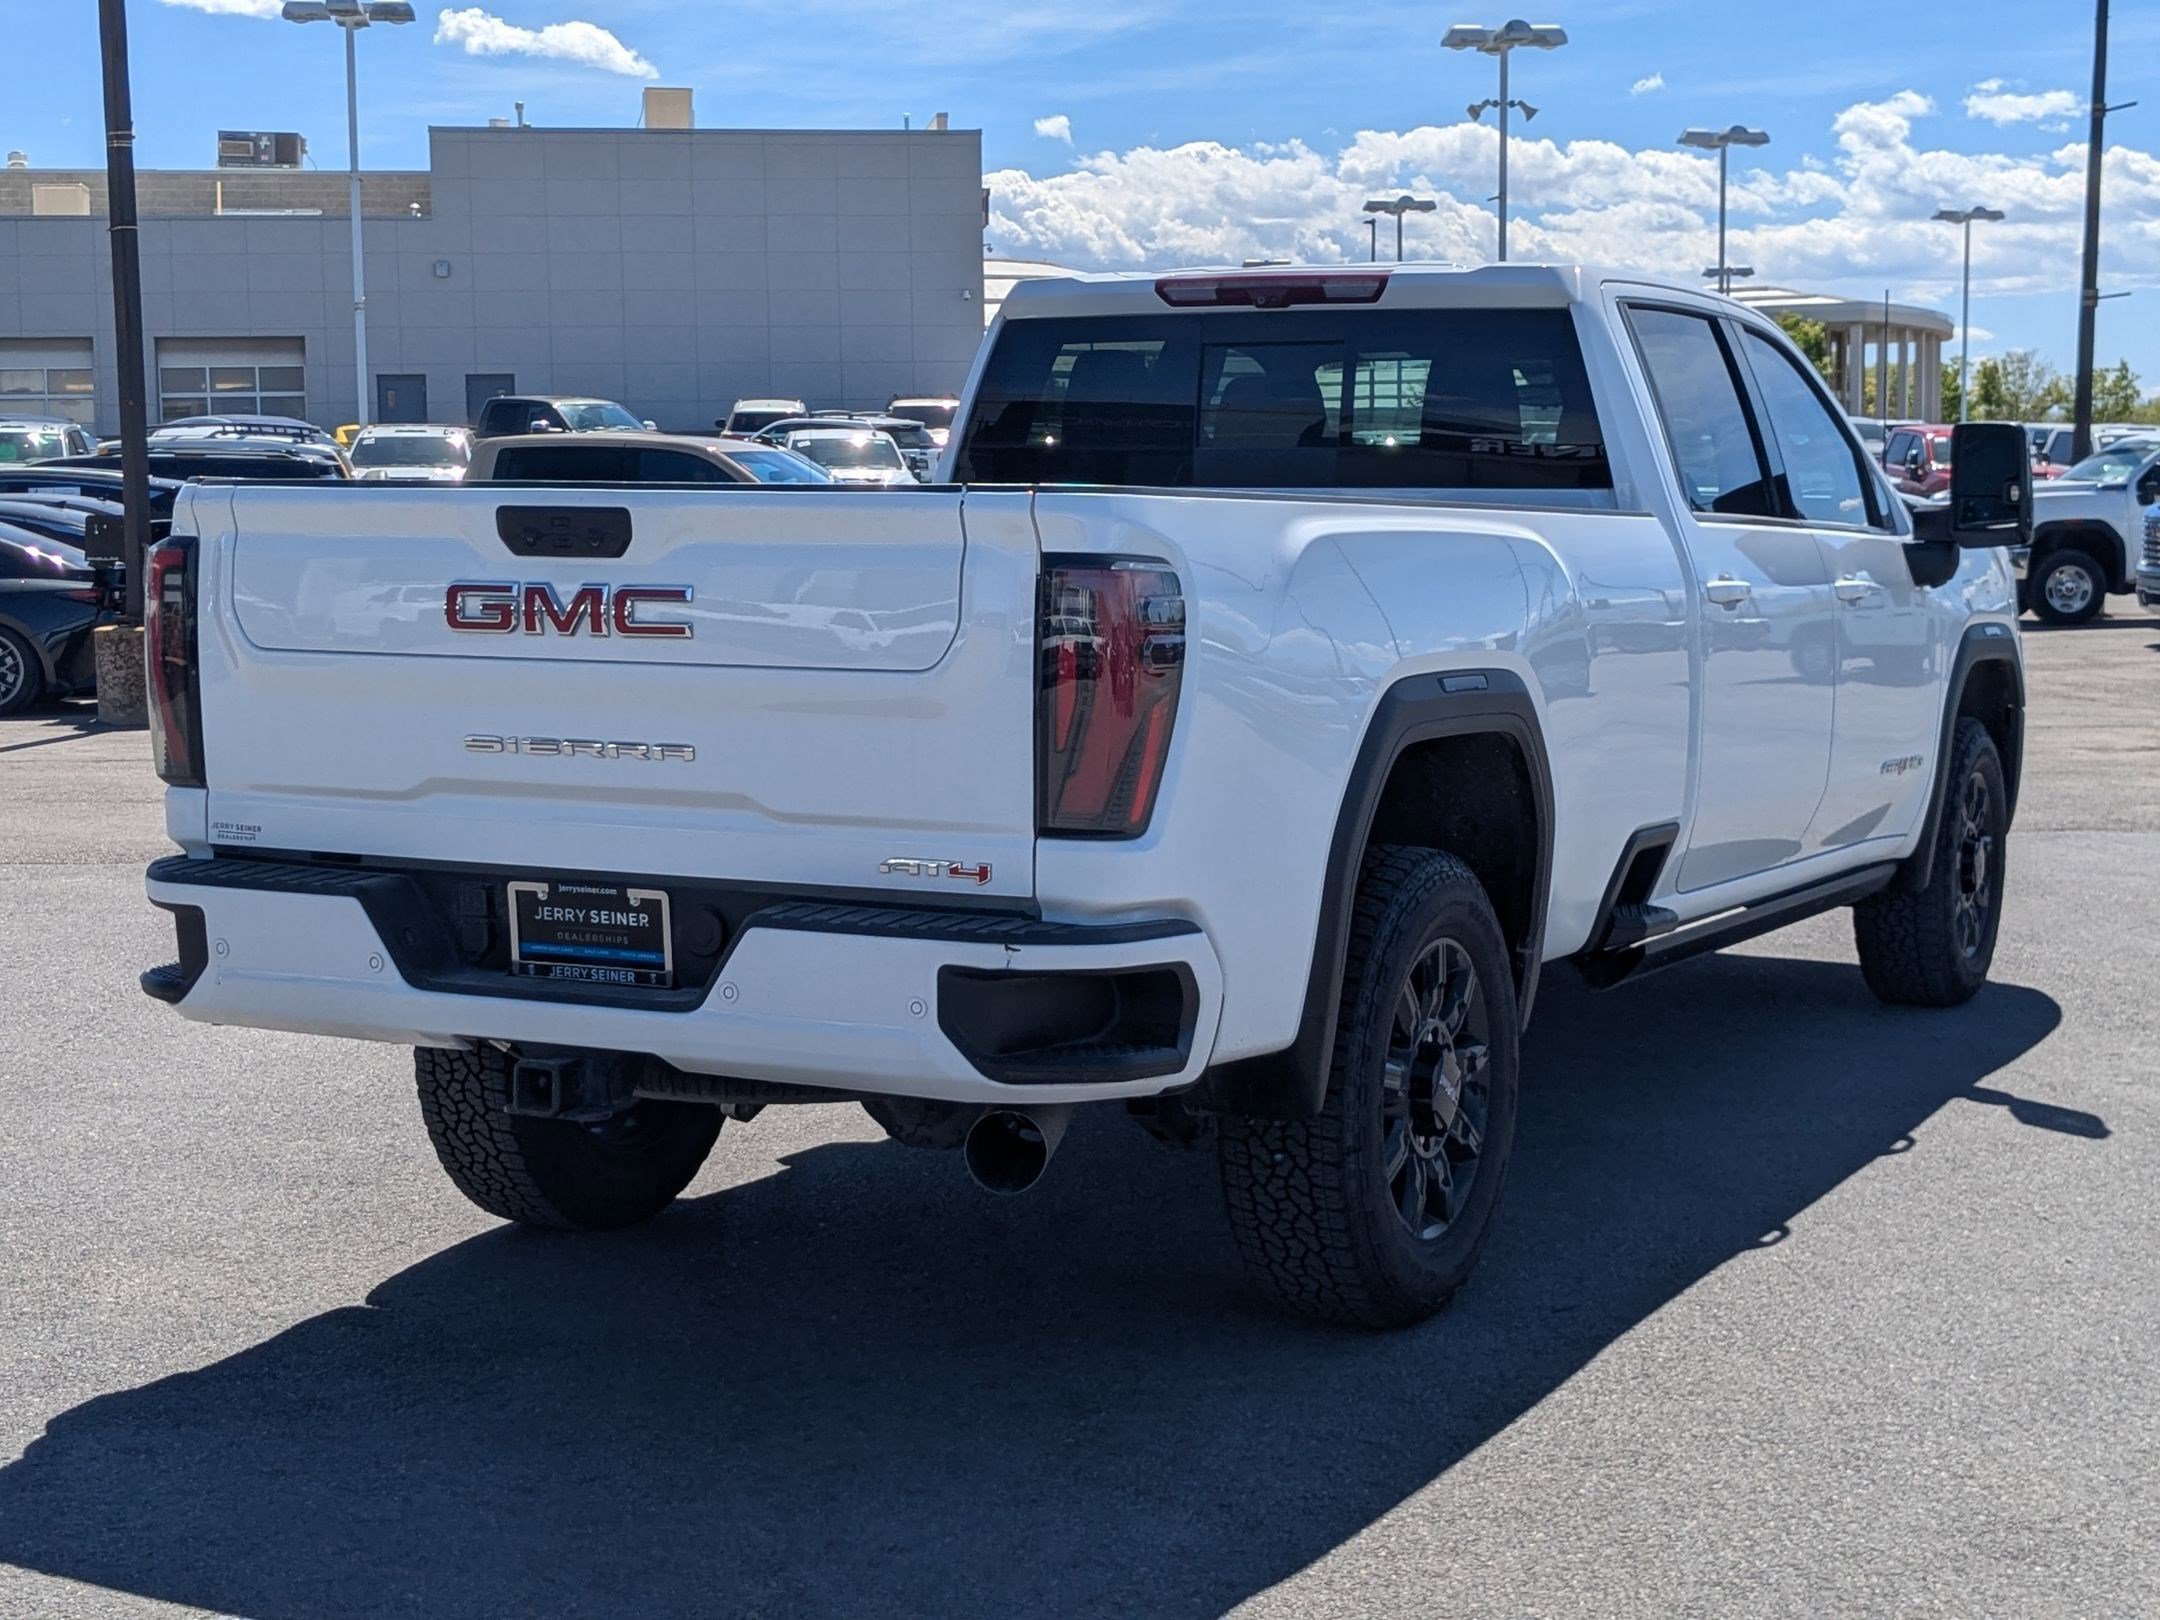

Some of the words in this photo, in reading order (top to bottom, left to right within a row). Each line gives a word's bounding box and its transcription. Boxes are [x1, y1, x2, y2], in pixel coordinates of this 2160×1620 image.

[443, 579, 694, 640] GMC
[463, 734, 696, 762] SIERRA
[879, 857, 992, 886] AT4
[558, 884, 618, 896] jerryseiner.com
[534, 906, 586, 923] JERRY
[590, 909, 650, 928] SEINER
[557, 931, 630, 945] DEALERSHIPS
[550, 965, 589, 979] JERRY
[590, 969, 636, 983] SEINER
